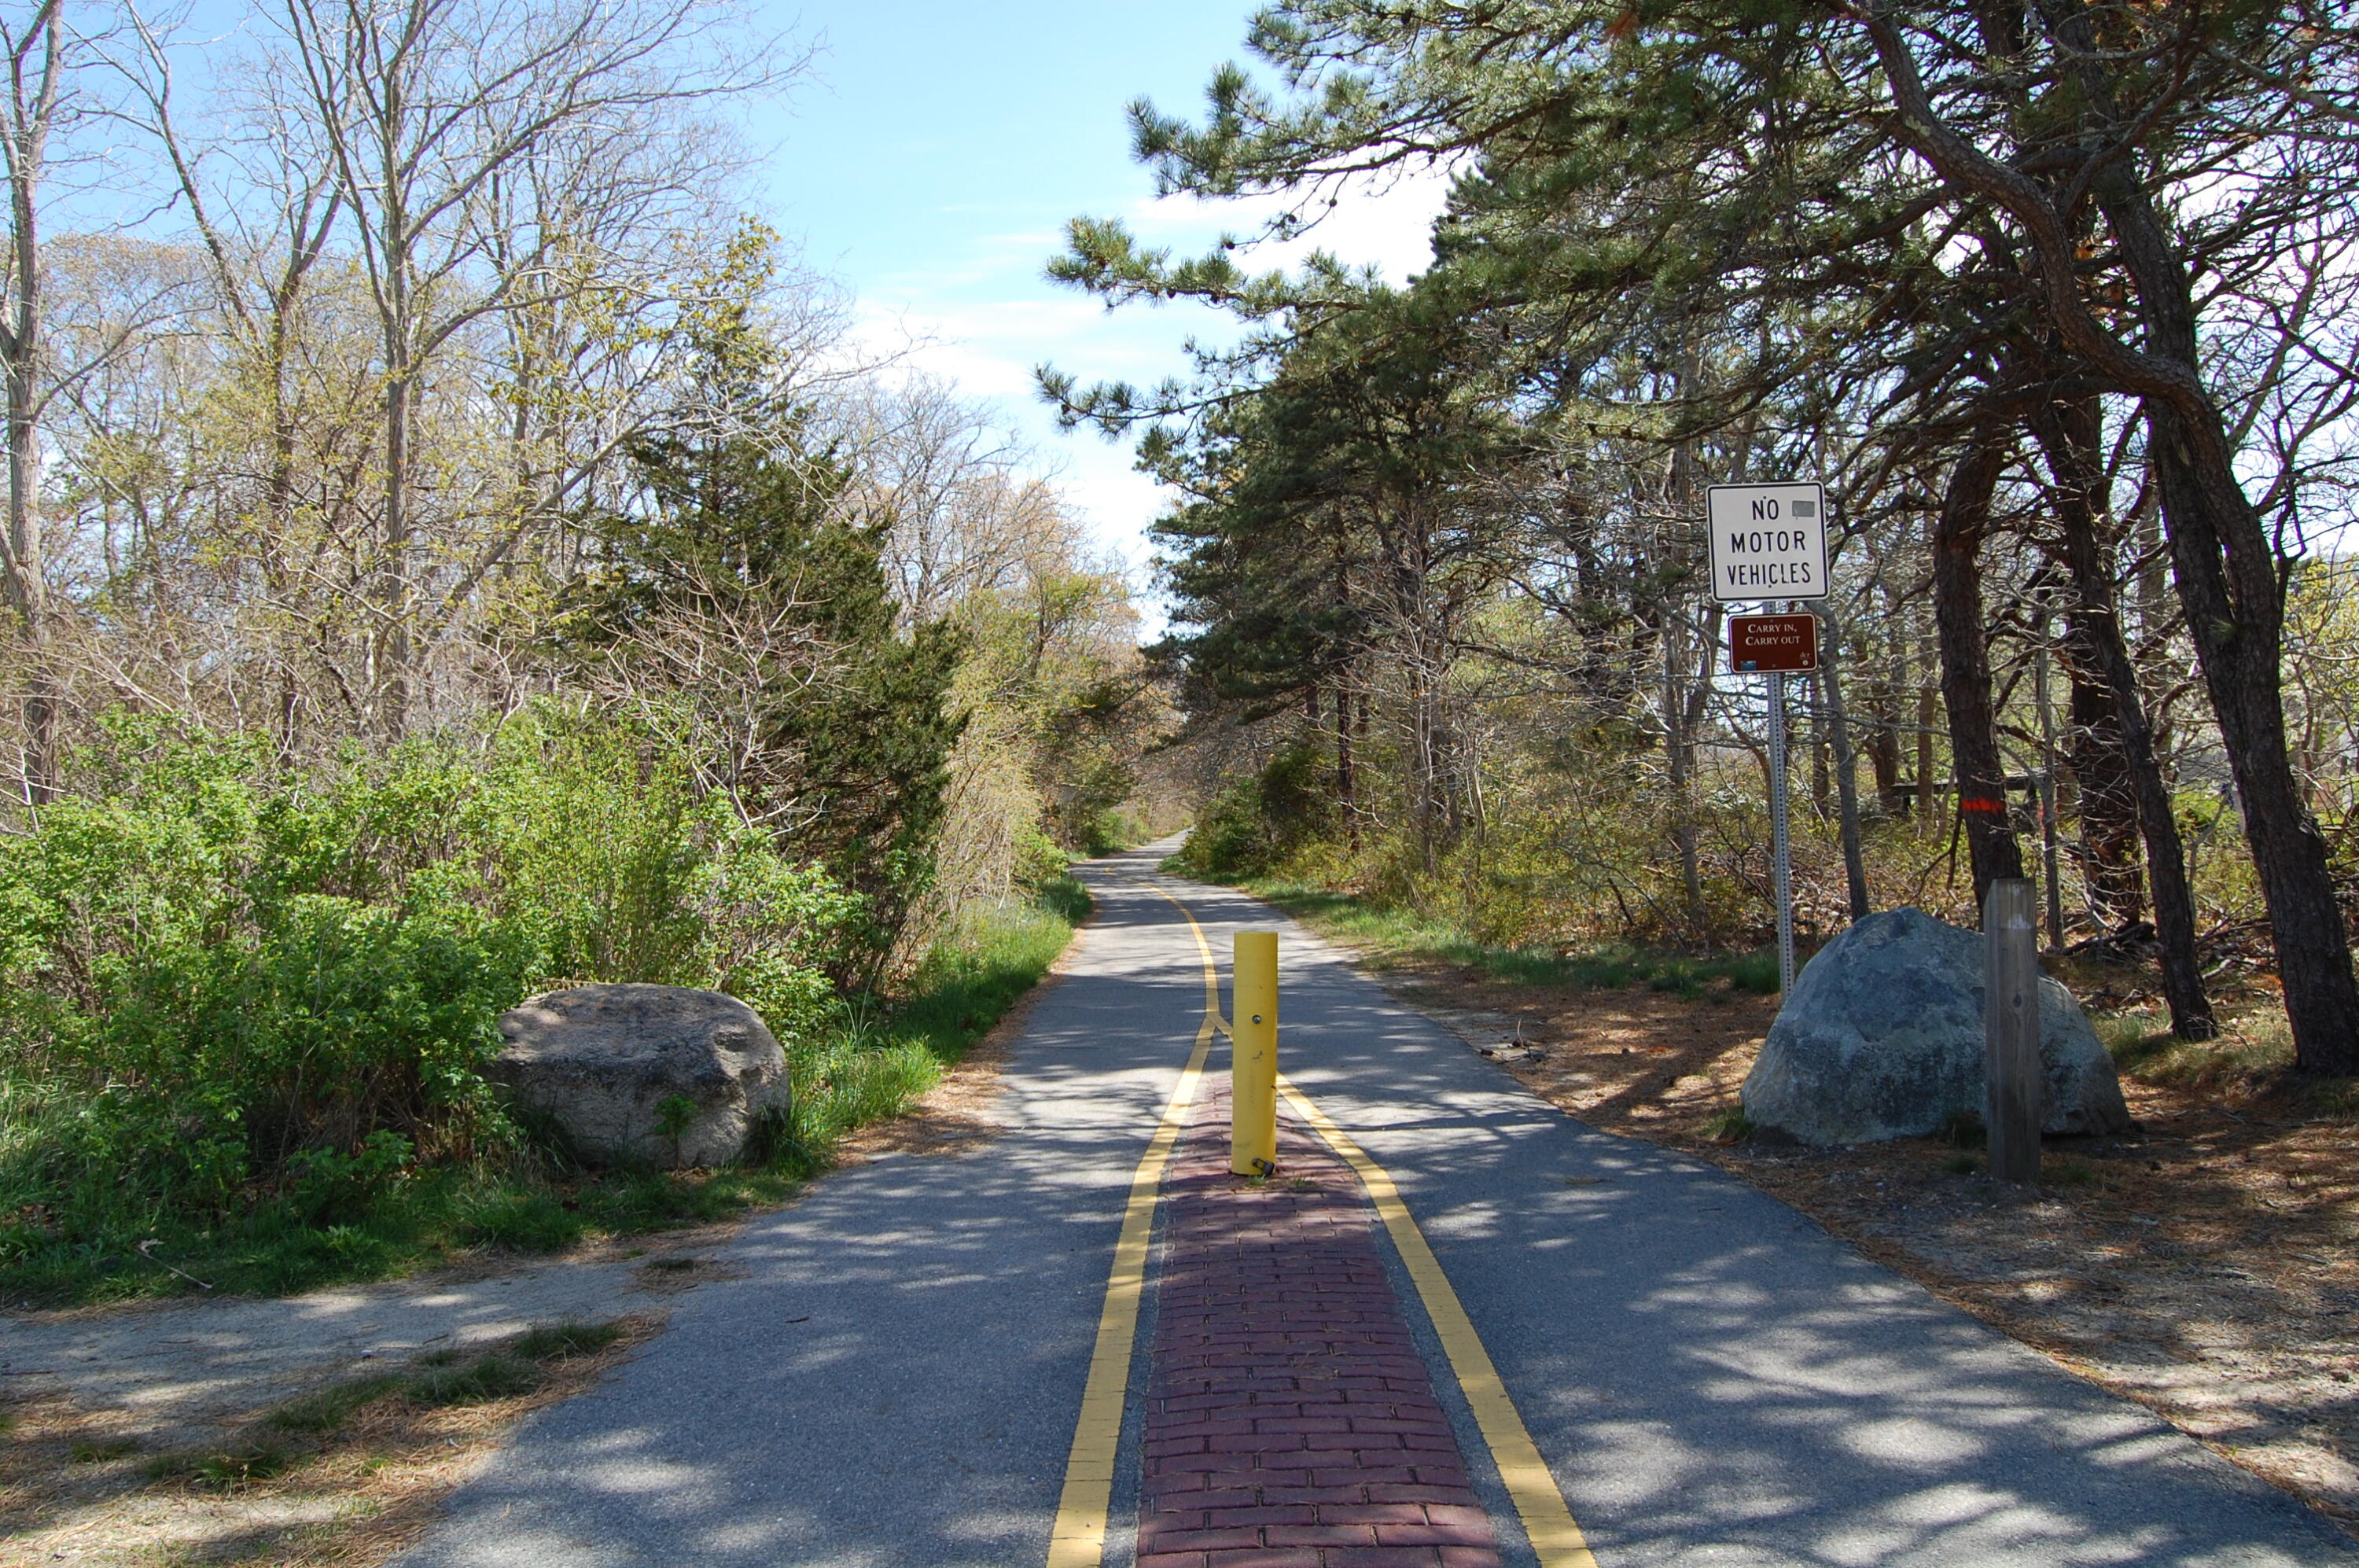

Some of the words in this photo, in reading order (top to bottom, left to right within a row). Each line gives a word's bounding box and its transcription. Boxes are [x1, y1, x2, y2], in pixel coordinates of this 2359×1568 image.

[1752, 499, 1779, 520] NO
[1731, 530, 1806, 553] MOTOR
[1727, 561, 1811, 585] VEHICLES
[1747, 624, 1781, 633] CARRY
[1745, 636, 1779, 646] CARRY
